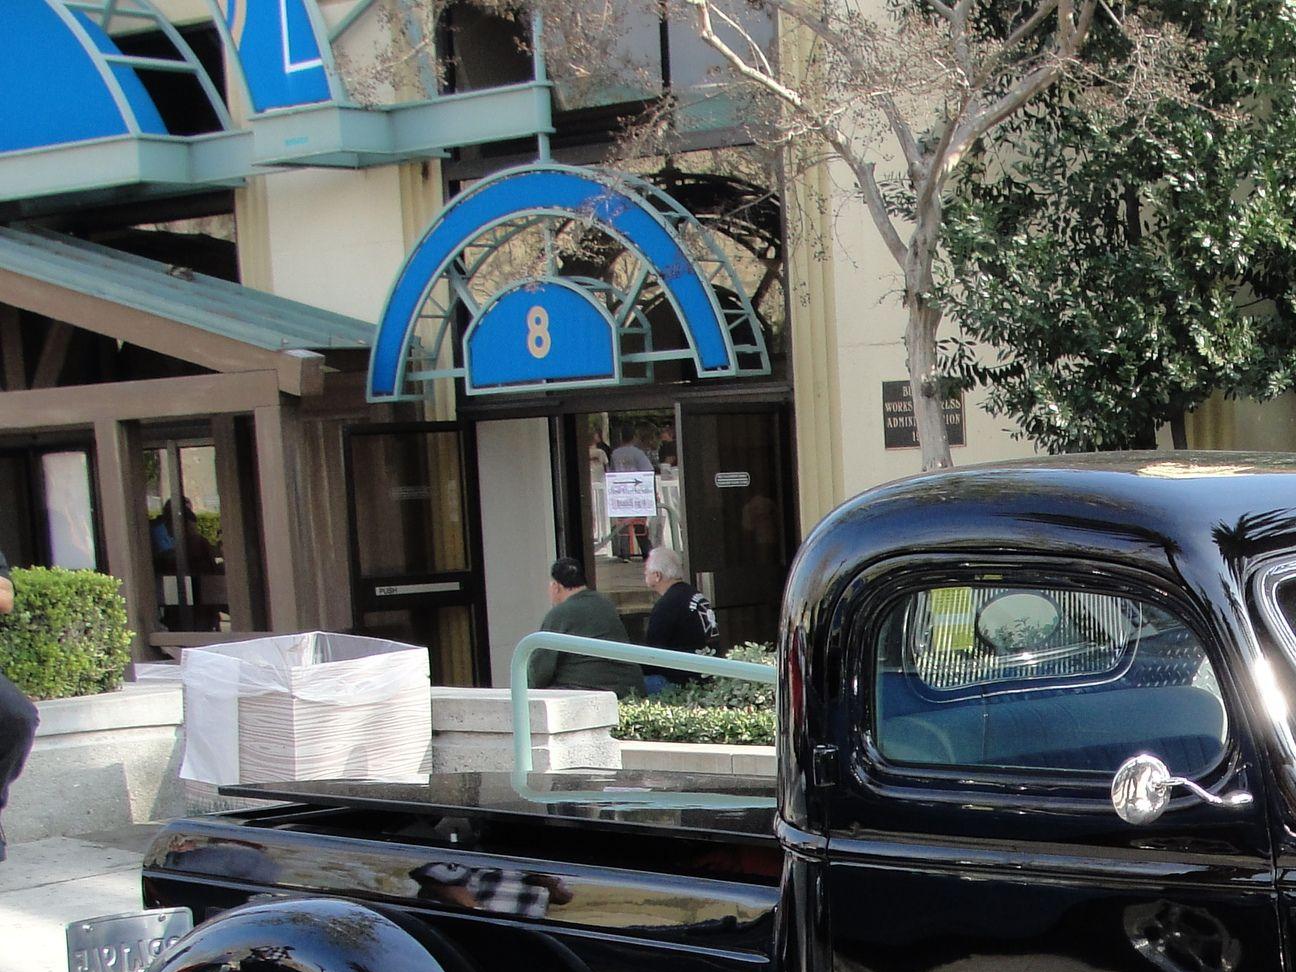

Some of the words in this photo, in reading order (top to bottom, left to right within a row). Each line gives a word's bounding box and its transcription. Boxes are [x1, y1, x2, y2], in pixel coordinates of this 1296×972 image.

[527, 306, 551, 358] 8
[885, 400, 913, 413] WORKS
[378, 586, 398, 596] PUSH
